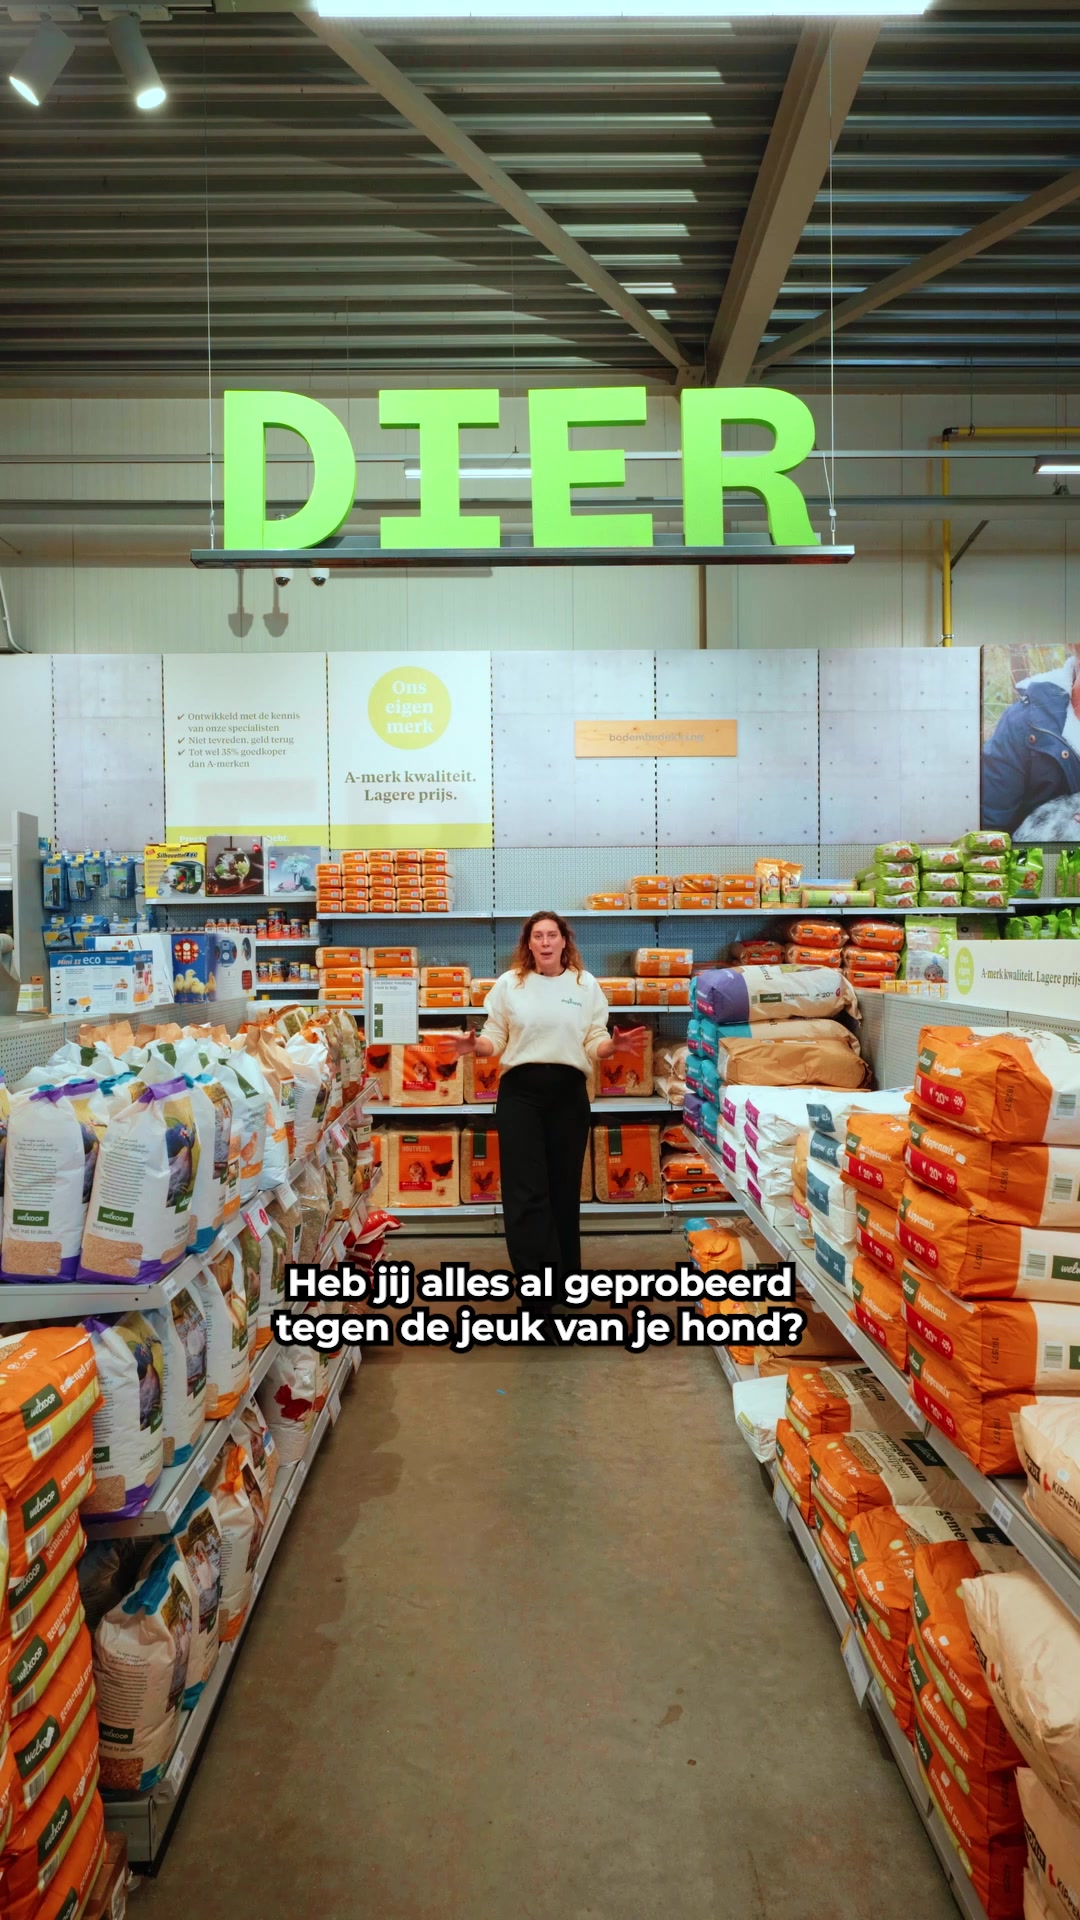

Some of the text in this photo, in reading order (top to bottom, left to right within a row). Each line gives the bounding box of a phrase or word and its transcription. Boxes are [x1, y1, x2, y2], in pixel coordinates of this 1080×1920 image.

[224, 387, 821, 549] DIER
[391, 680, 427, 694] Ons
[187, 711, 301, 721] Ontwikkeld met de kennis
[385, 699, 434, 717] eigen
[205, 725, 227, 733] onze
[228, 723, 280, 735] specialisten
[386, 720, 434, 734] merk
[188, 735, 294, 746] Niet tevreden, geld terug
[609, 733, 704, 742] bodembedekking
[188, 747, 287, 758] Tot wel 35% goedkoper
[188, 760, 250, 768] dan A-merken
[344, 770, 477, 783] A-merk kwaliteit.
[364, 788, 458, 804] Lagere prijs.
[82, 956, 101, 965] eco
[981, 968, 1004, 979] A-merk
[1003, 968, 1036, 982] kwaliteit.
[1036, 970, 1062, 987] Lagere
[922, 1136, 955, 1157] kippenmix
[907, 1208, 935, 1231] kippenmix
[917, 1293, 948, 1321] kippenmix
[922, 1368, 950, 1399] kippenmix
[45, 1519, 71, 1561] gemengd
[46, 1596, 74, 1643] gemengd
[948, 1667, 973, 1700] graan
[60, 1676, 85, 1723] gemengd
[921, 1693, 949, 1737] gemengd
[947, 1733, 969, 1763] graan
[930, 1768, 972, 1849] gemengd graan
